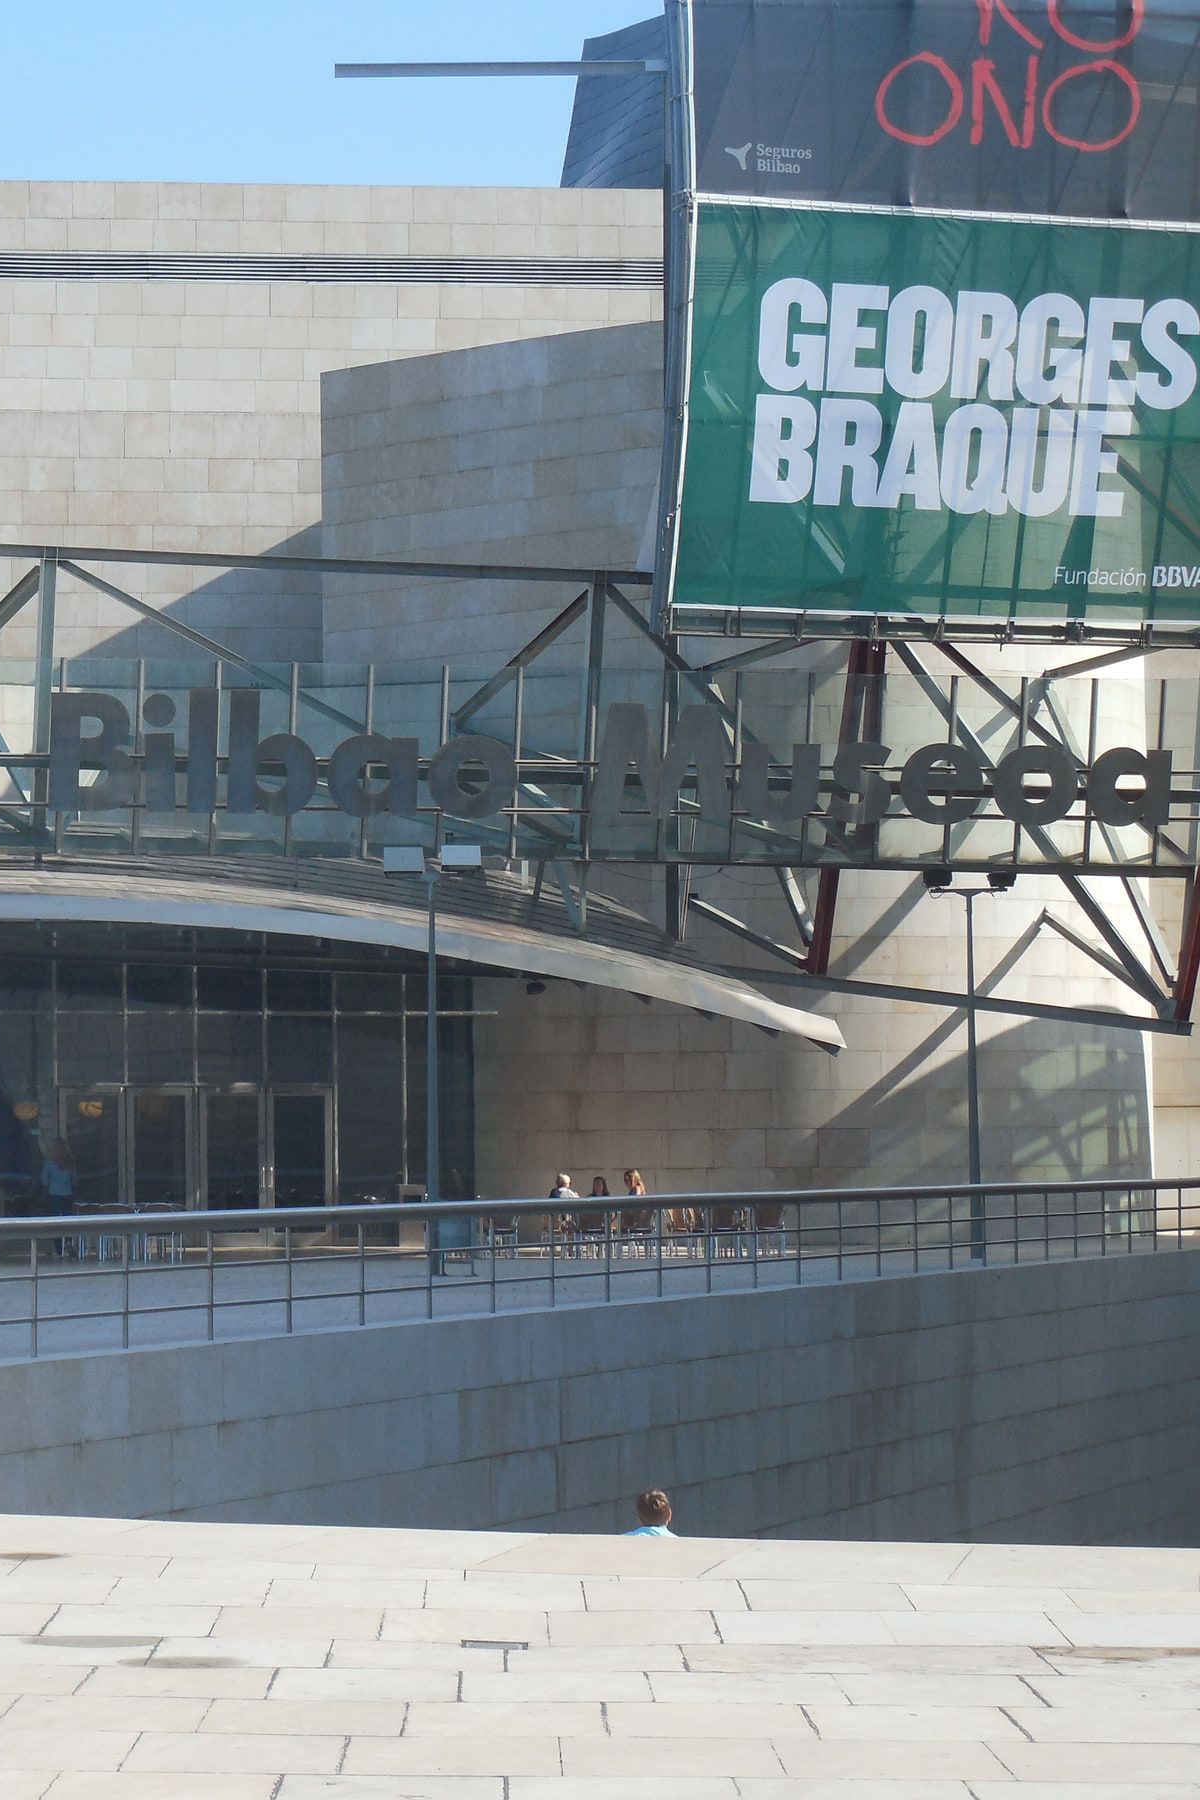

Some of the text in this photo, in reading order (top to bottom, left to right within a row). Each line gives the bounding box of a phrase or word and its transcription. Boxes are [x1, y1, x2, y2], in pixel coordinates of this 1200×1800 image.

[756, 144, 812, 160] Seguros
[875, 50, 1141, 152] ONO
[757, 159, 800, 174] Bilbao
[758, 277, 1200, 410] GEORGES
[749, 394, 1132, 517] BRAQUE
[1054, 566, 1147, 587] Fundación
[51, 687, 519, 818] Bilbao
[601, 703, 1171, 825] Museoa
